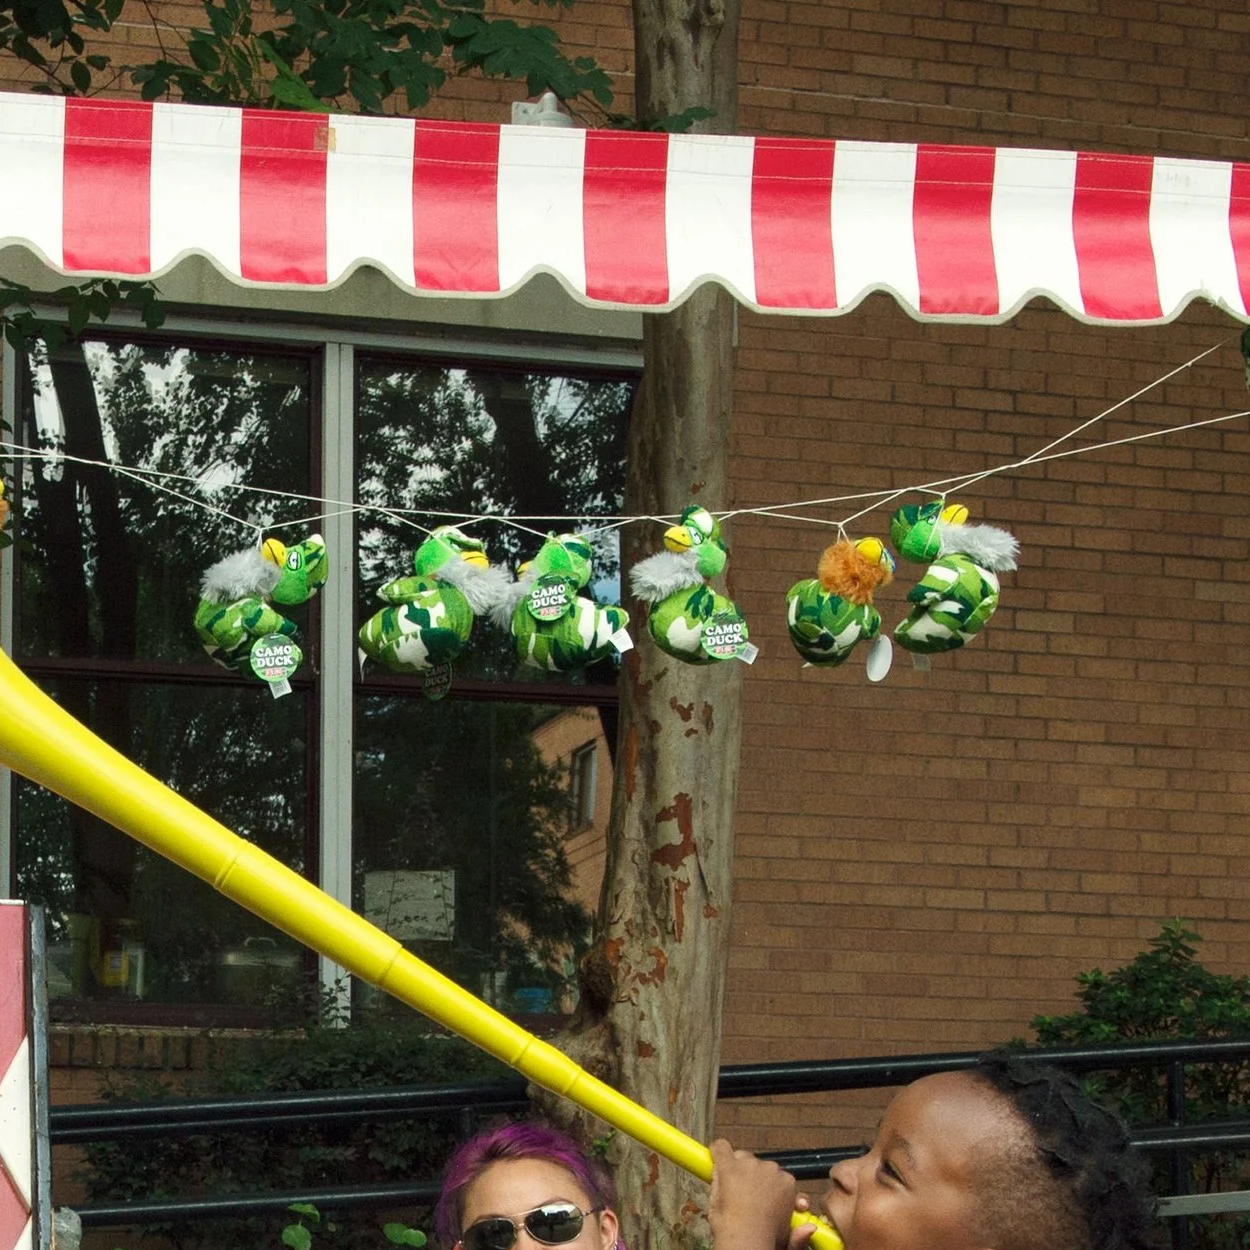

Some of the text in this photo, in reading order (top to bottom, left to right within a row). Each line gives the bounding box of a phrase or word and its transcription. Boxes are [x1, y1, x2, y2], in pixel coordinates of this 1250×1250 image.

[532, 584, 565, 599] CAMO
[533, 594, 568, 609] DUCK
[705, 623, 742, 636] CAMO
[707, 633, 743, 646] DUCK
[255, 645, 292, 658] CAMO
[257, 656, 294, 668] DUCK
